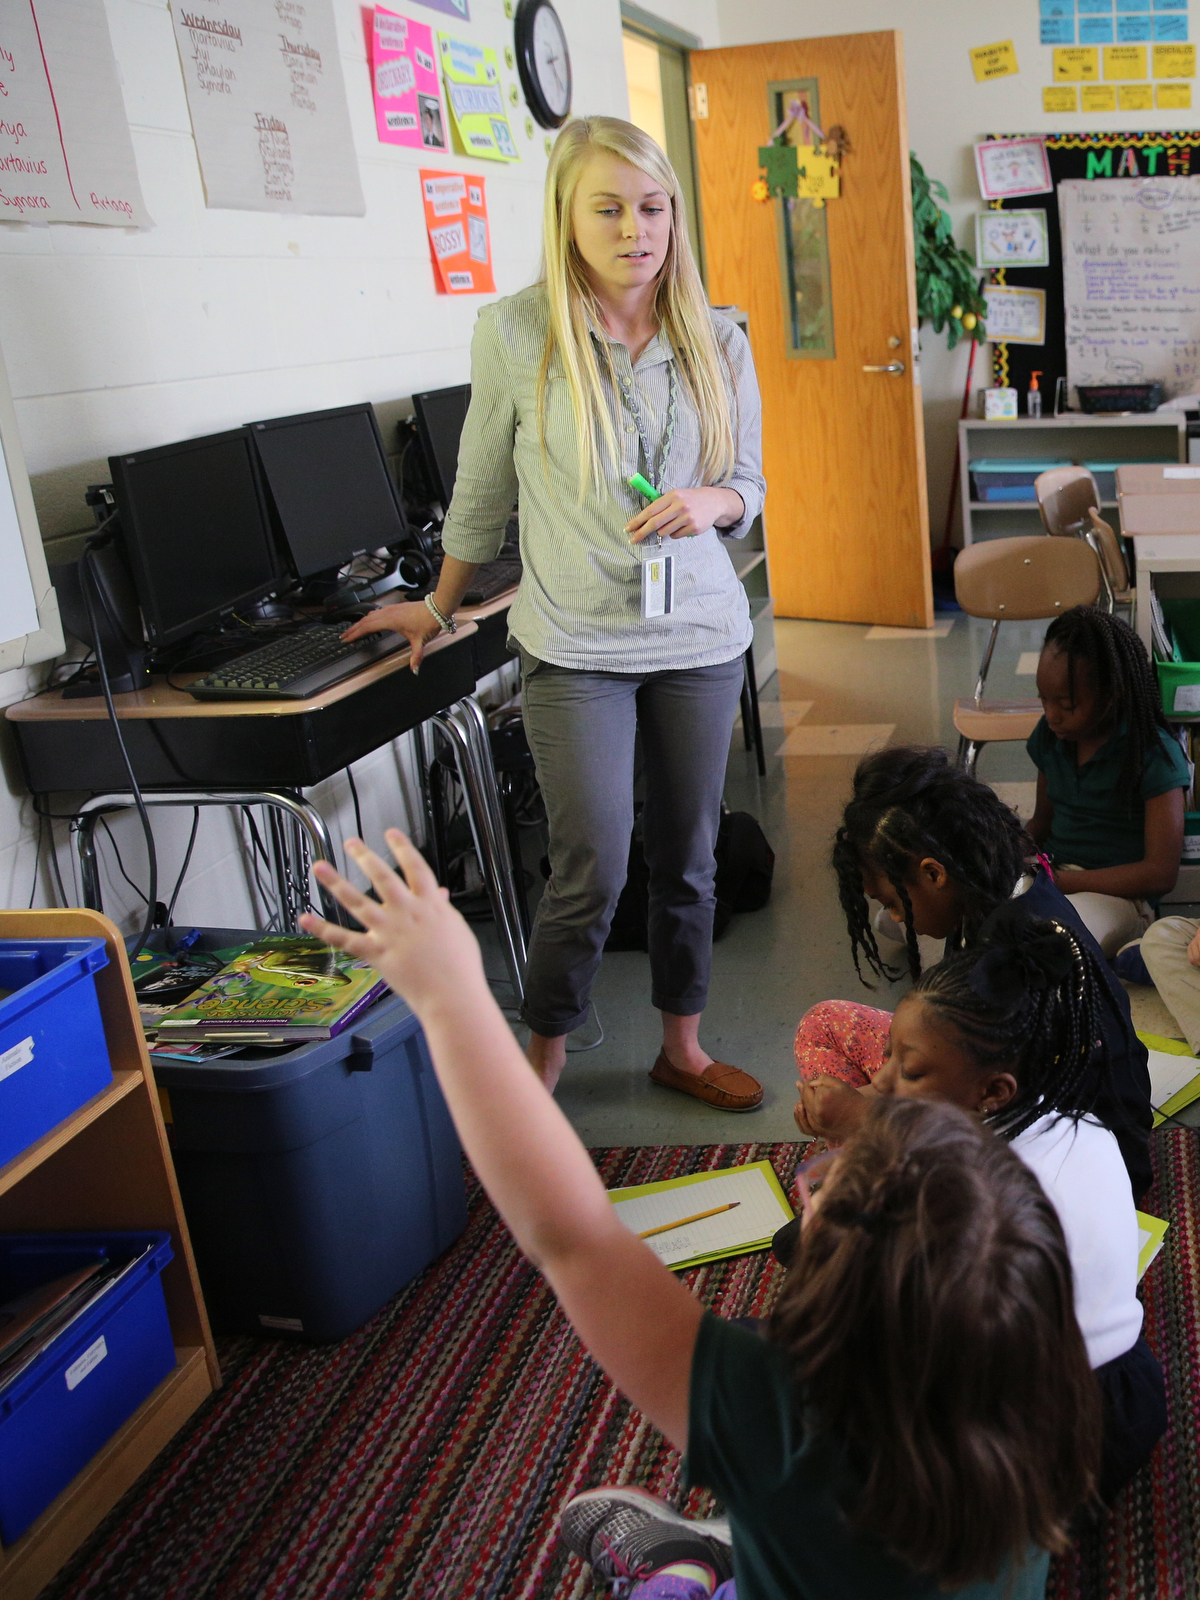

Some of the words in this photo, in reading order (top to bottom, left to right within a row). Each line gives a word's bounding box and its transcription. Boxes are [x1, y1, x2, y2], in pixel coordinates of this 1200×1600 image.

[181, 9, 243, 46] Wednesday
[278, 33, 322, 67] Thursday
[451, 88, 500, 111] CURIOUS
[254, 112, 288, 140] Friday
[1085, 146, 1191, 180] MATH
[433, 229, 463, 254] BOSSY
[197, 996, 333, 1013] Science
[206, 1008, 299, 1018] Tennessee
